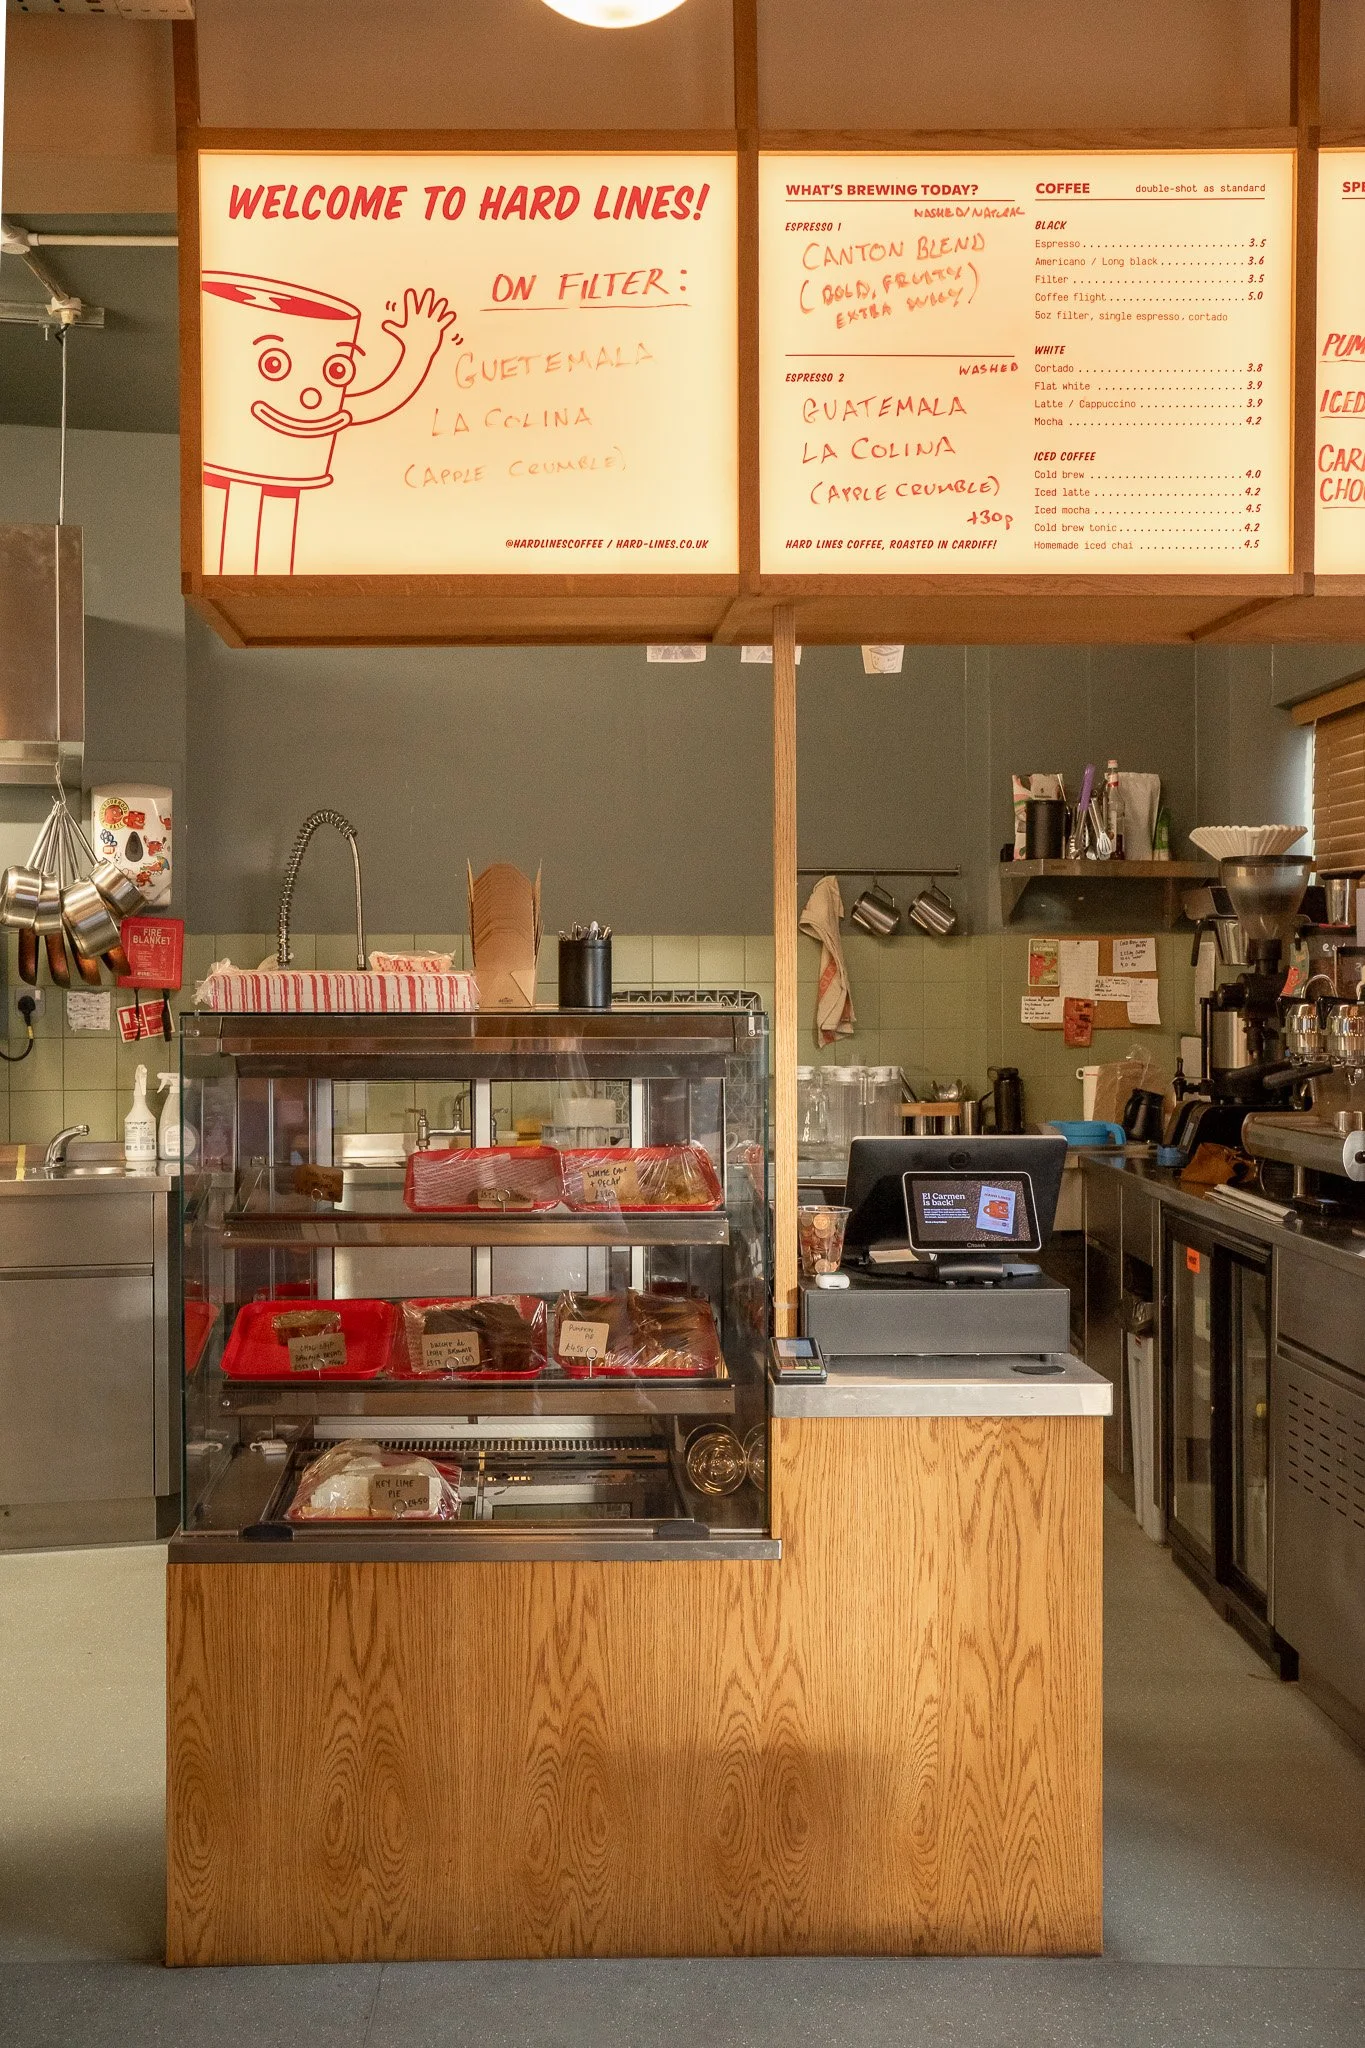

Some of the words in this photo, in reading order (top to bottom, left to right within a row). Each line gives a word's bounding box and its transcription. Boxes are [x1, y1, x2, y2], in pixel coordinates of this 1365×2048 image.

[786, 184, 842, 195] WHAT'S
[848, 185, 917, 195] BREWING
[921, 185, 978, 195] TODAY?
[1036, 183, 1089, 193] COFFEE
[1136, 184, 1197, 192] double-shot
[1221, 184, 1265, 192] standard
[229, 185, 408, 220] WELCOME
[424, 186, 466, 220] TO
[479, 186, 580, 220] HARD
[594, 183, 710, 220] LINES!
[785, 222, 833, 231] ESPRESSO
[838, 223, 841, 231] 1
[1035, 221, 1067, 230] BLACK
[1036, 240, 1080, 249] Espresso
[1249, 238, 1266, 247] 3.5
[802, 240, 904, 271] CANTON
[916, 232, 986, 261] BLEND
[1102, 258, 1124, 267] Long
[1130, 257, 1157, 265] black
[1248, 256, 1264, 265] 3.6
[1036, 275, 1068, 283] Filter
[1248, 274, 1264, 283] 3.5
[491, 273, 537, 302] ON
[1035, 293, 1068, 301] Coffee
[1074, 293, 1106, 303] flight
[1248, 291, 1263, 300] 5.0
[836, 302, 893, 329] EXTRA
[1035, 311, 1051, 319] 5oz
[1057, 311, 1093, 320] filter,
[1099, 312, 1132, 322] single
[1189, 313, 1227, 321] cortado
[1035, 346, 1065, 354] WHITE
[959, 362, 1019, 376] WASHED
[1035, 364, 1073, 372] Cortado
[1247, 363, 1263, 372] 3.8
[786, 373, 833, 382] ESPRESSO
[839, 373, 844, 382] 2
[1035, 382, 1057, 390] Flat
[1063, 382, 1090, 390] white
[1247, 381, 1262, 389] 3.9
[1035, 400, 1063, 408] Latte
[1079, 400, 1136, 409] Cappuccino
[1247, 399, 1263, 407] 3.9
[803, 396, 967, 424] GUATEMALA
[432, 408, 469, 436] LA
[1246, 416, 1261, 425] 4.2
[802, 442, 838, 464] LA
[851, 436, 956, 459] COLINA
[1034, 452, 1056, 461] ICED
[1061, 452, 1096, 461] COFFEE
[1318, 444, 1365, 472] CAR
[1035, 470, 1056, 478] Cold
[1246, 470, 1261, 478] 4.0
[810, 481, 887, 504] (APPLE
[896, 475, 1000, 497] CRUMBLE)
[1035, 488, 1056, 496] Iced
[1063, 488, 1090, 496] latte
[1245, 487, 1260, 496] 4.2
[1320, 478, 1365, 502] CHO
[1035, 506, 1056, 514] Iced
[1246, 504, 1261, 512] 4.5
[1035, 523, 1056, 531] Cold
[1245, 523, 1260, 532] 4.2
[506, 539, 603, 548] @HARDLINESCOFFEE
[616, 540, 708, 548] HARD-LINES.CO.UK
[786, 540, 812, 548] HARD
[817, 540, 843, 548] LINES
[847, 540, 884, 550] COFFEE,
[890, 540, 934, 549] ROASTED
[938, 540, 948, 549] IN
[952, 540, 997, 549] CARDIFF!
[1085, 541, 1106, 549] iced
[1244, 540, 1259, 548] 4.5
[144, 928, 162, 937] FIRE
[132, 935, 171, 945] BLANKET
[921, 1192, 931, 1200] El
[932, 1192, 966, 1200] Carmen
[375, 1479, 391, 1488] KEY
[395, 1479, 415, 1488] LIME
[388, 1489, 401, 1498] PIE
